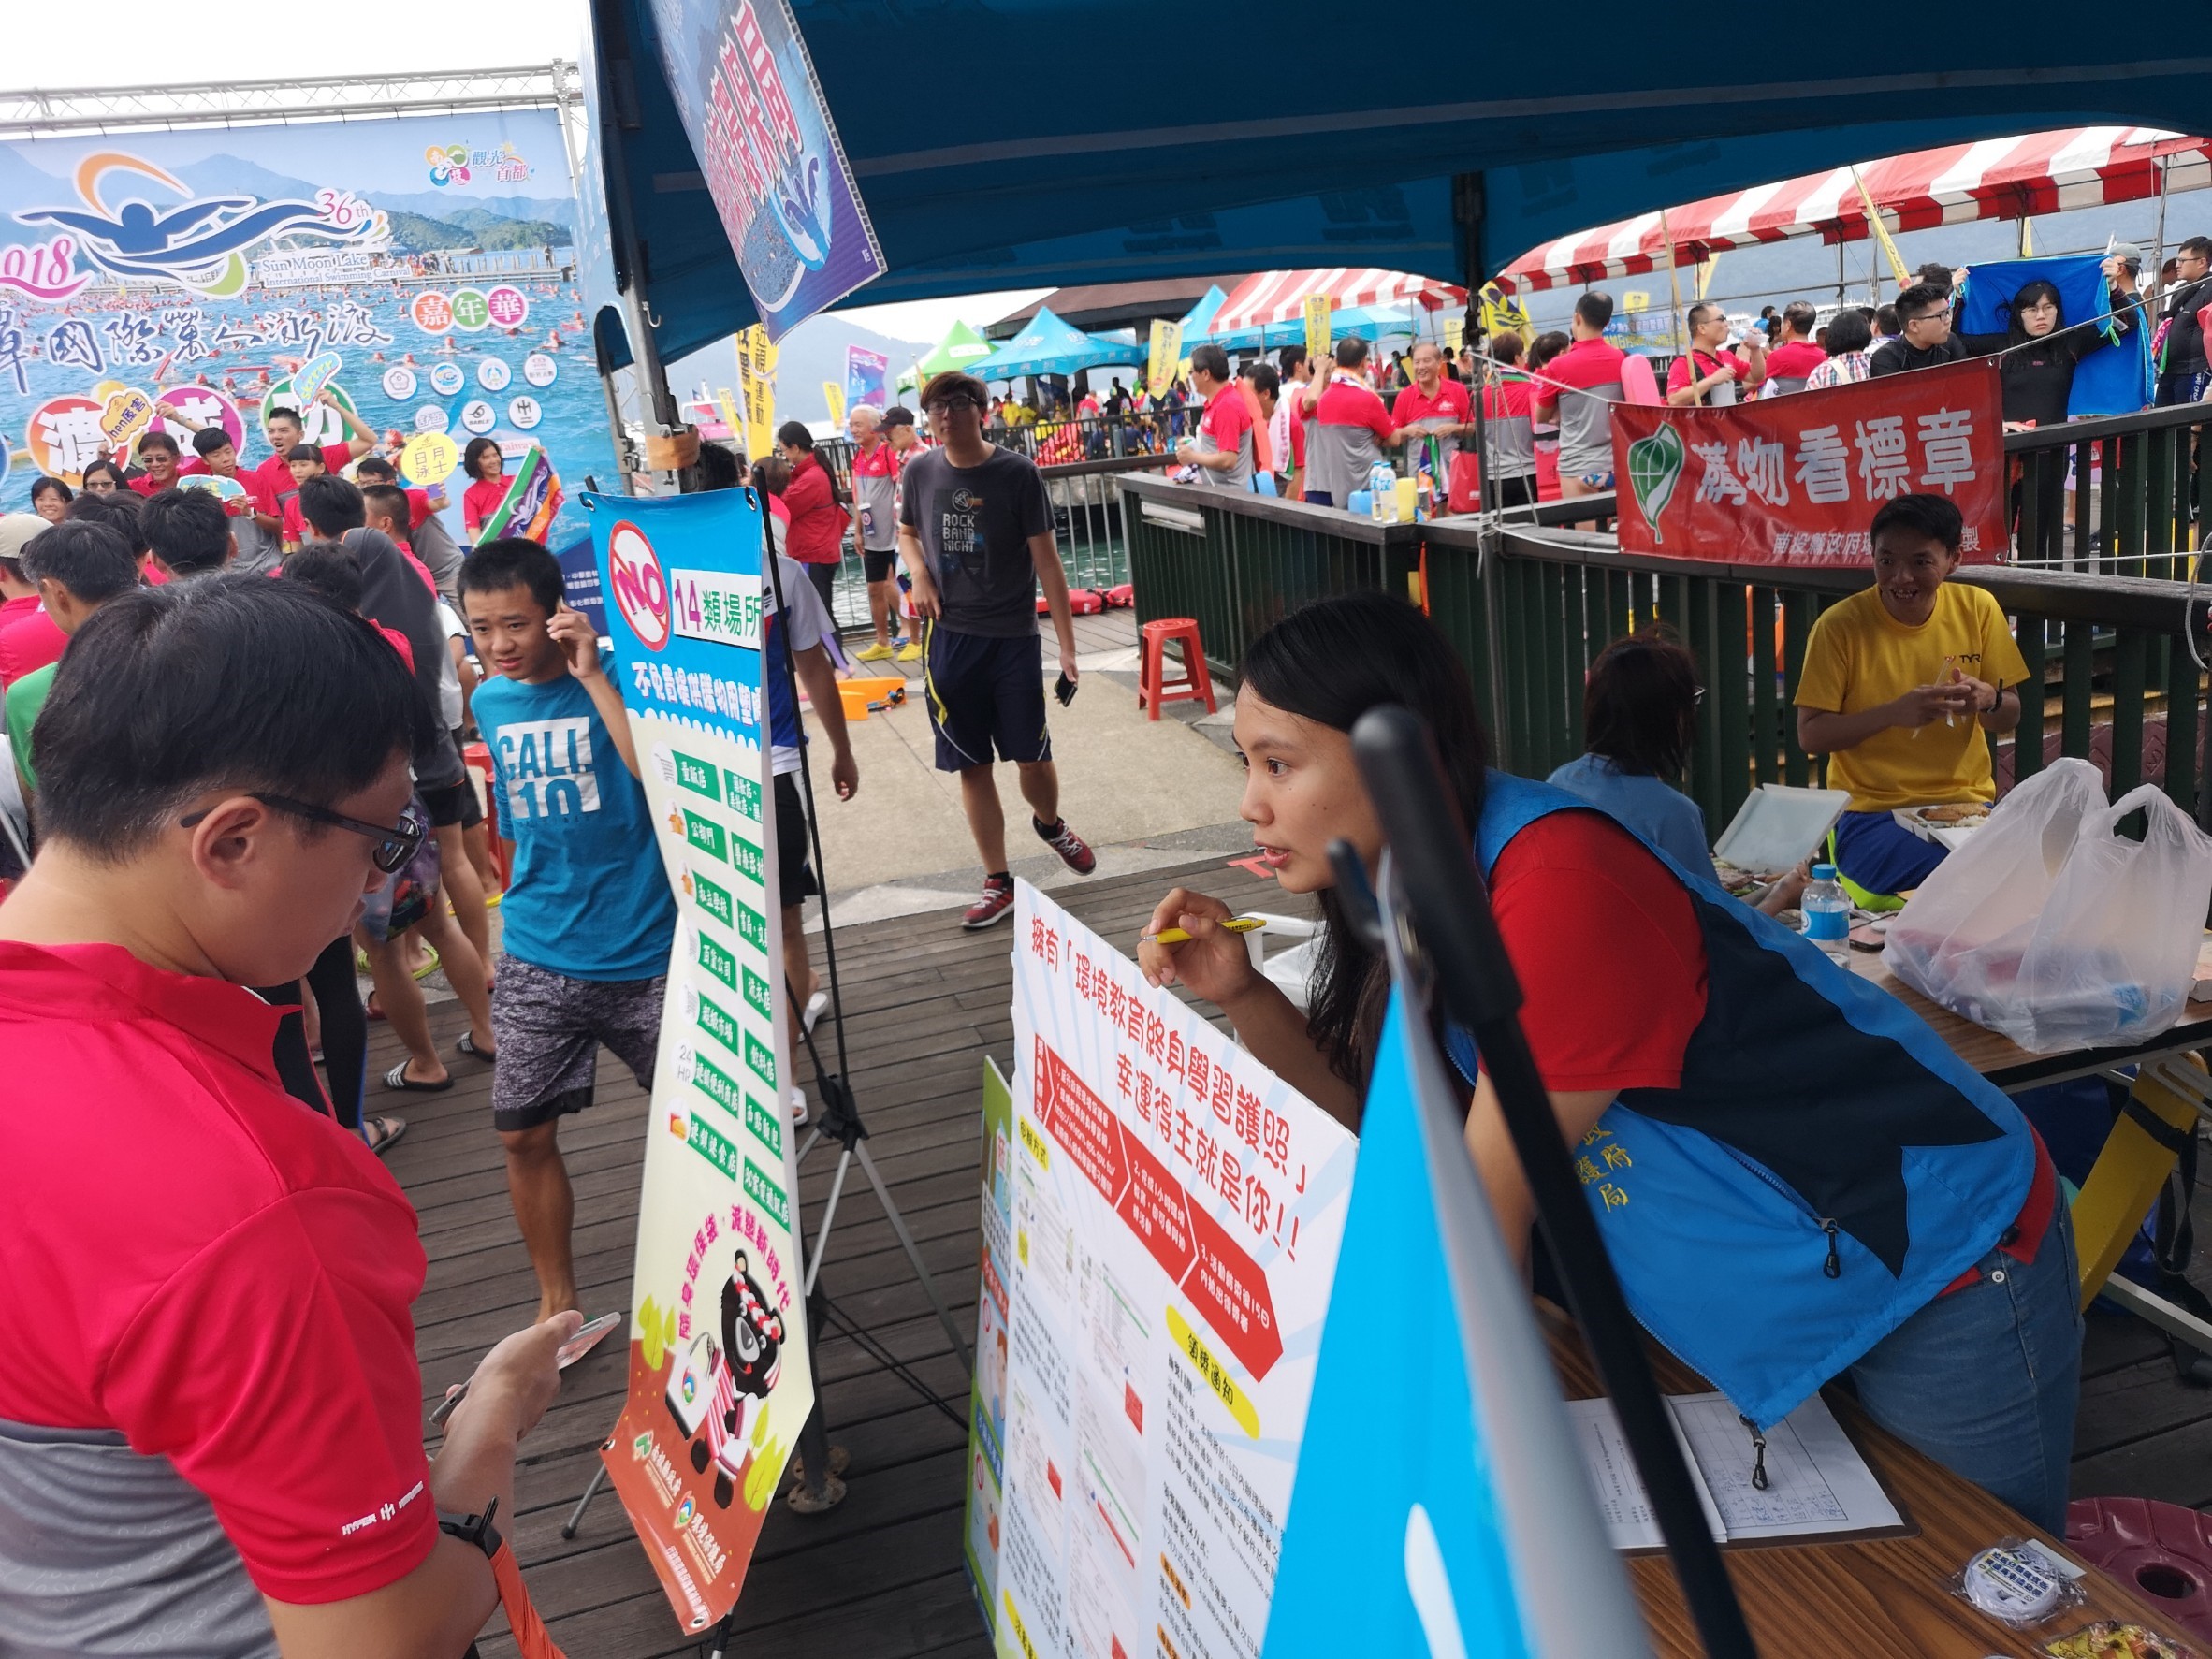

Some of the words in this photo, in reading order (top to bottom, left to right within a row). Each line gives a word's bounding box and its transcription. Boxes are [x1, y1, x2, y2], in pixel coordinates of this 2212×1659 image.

[317, 192, 370, 225] 36th
[0, 238, 72, 286] 018
[261, 259, 288, 274] Sun
[292, 256, 331, 272] Moon
[336, 253, 368, 267] Lake
[266, 274, 323, 286] International
[324, 270, 372, 283] Swimming
[374, 267, 411, 278] Carnival
[417, 292, 524, 327] 嘉年華
[942, 513, 975, 527] ROCK
[942, 527, 975, 540] BAND
[943, 540, 975, 552] NIGHT
[616, 560, 668, 617] NO
[674, 578, 762, 638] 14類場所
[1959, 654, 1981, 663] TYR
[497, 728, 579, 780] CALI
[681, 760, 707, 790] 量販店
[691, 820, 717, 850] 公部門
[698, 881, 729, 919] 私立學校
[703, 942, 731, 981] 百貨公司
[748, 977, 772, 1010] 洗衣店
[701, 1003, 734, 1042] 超級市場
[679, 1045, 691, 1062] 24
[750, 1045, 776, 1082] 飲料店
[677, 1065, 691, 1083] HR
[696, 1060, 739, 1111] 連鎖便利商店
[691, 1120, 737, 1172] 連鎖速食店
[342, 1512, 377, 1535] HYPER
